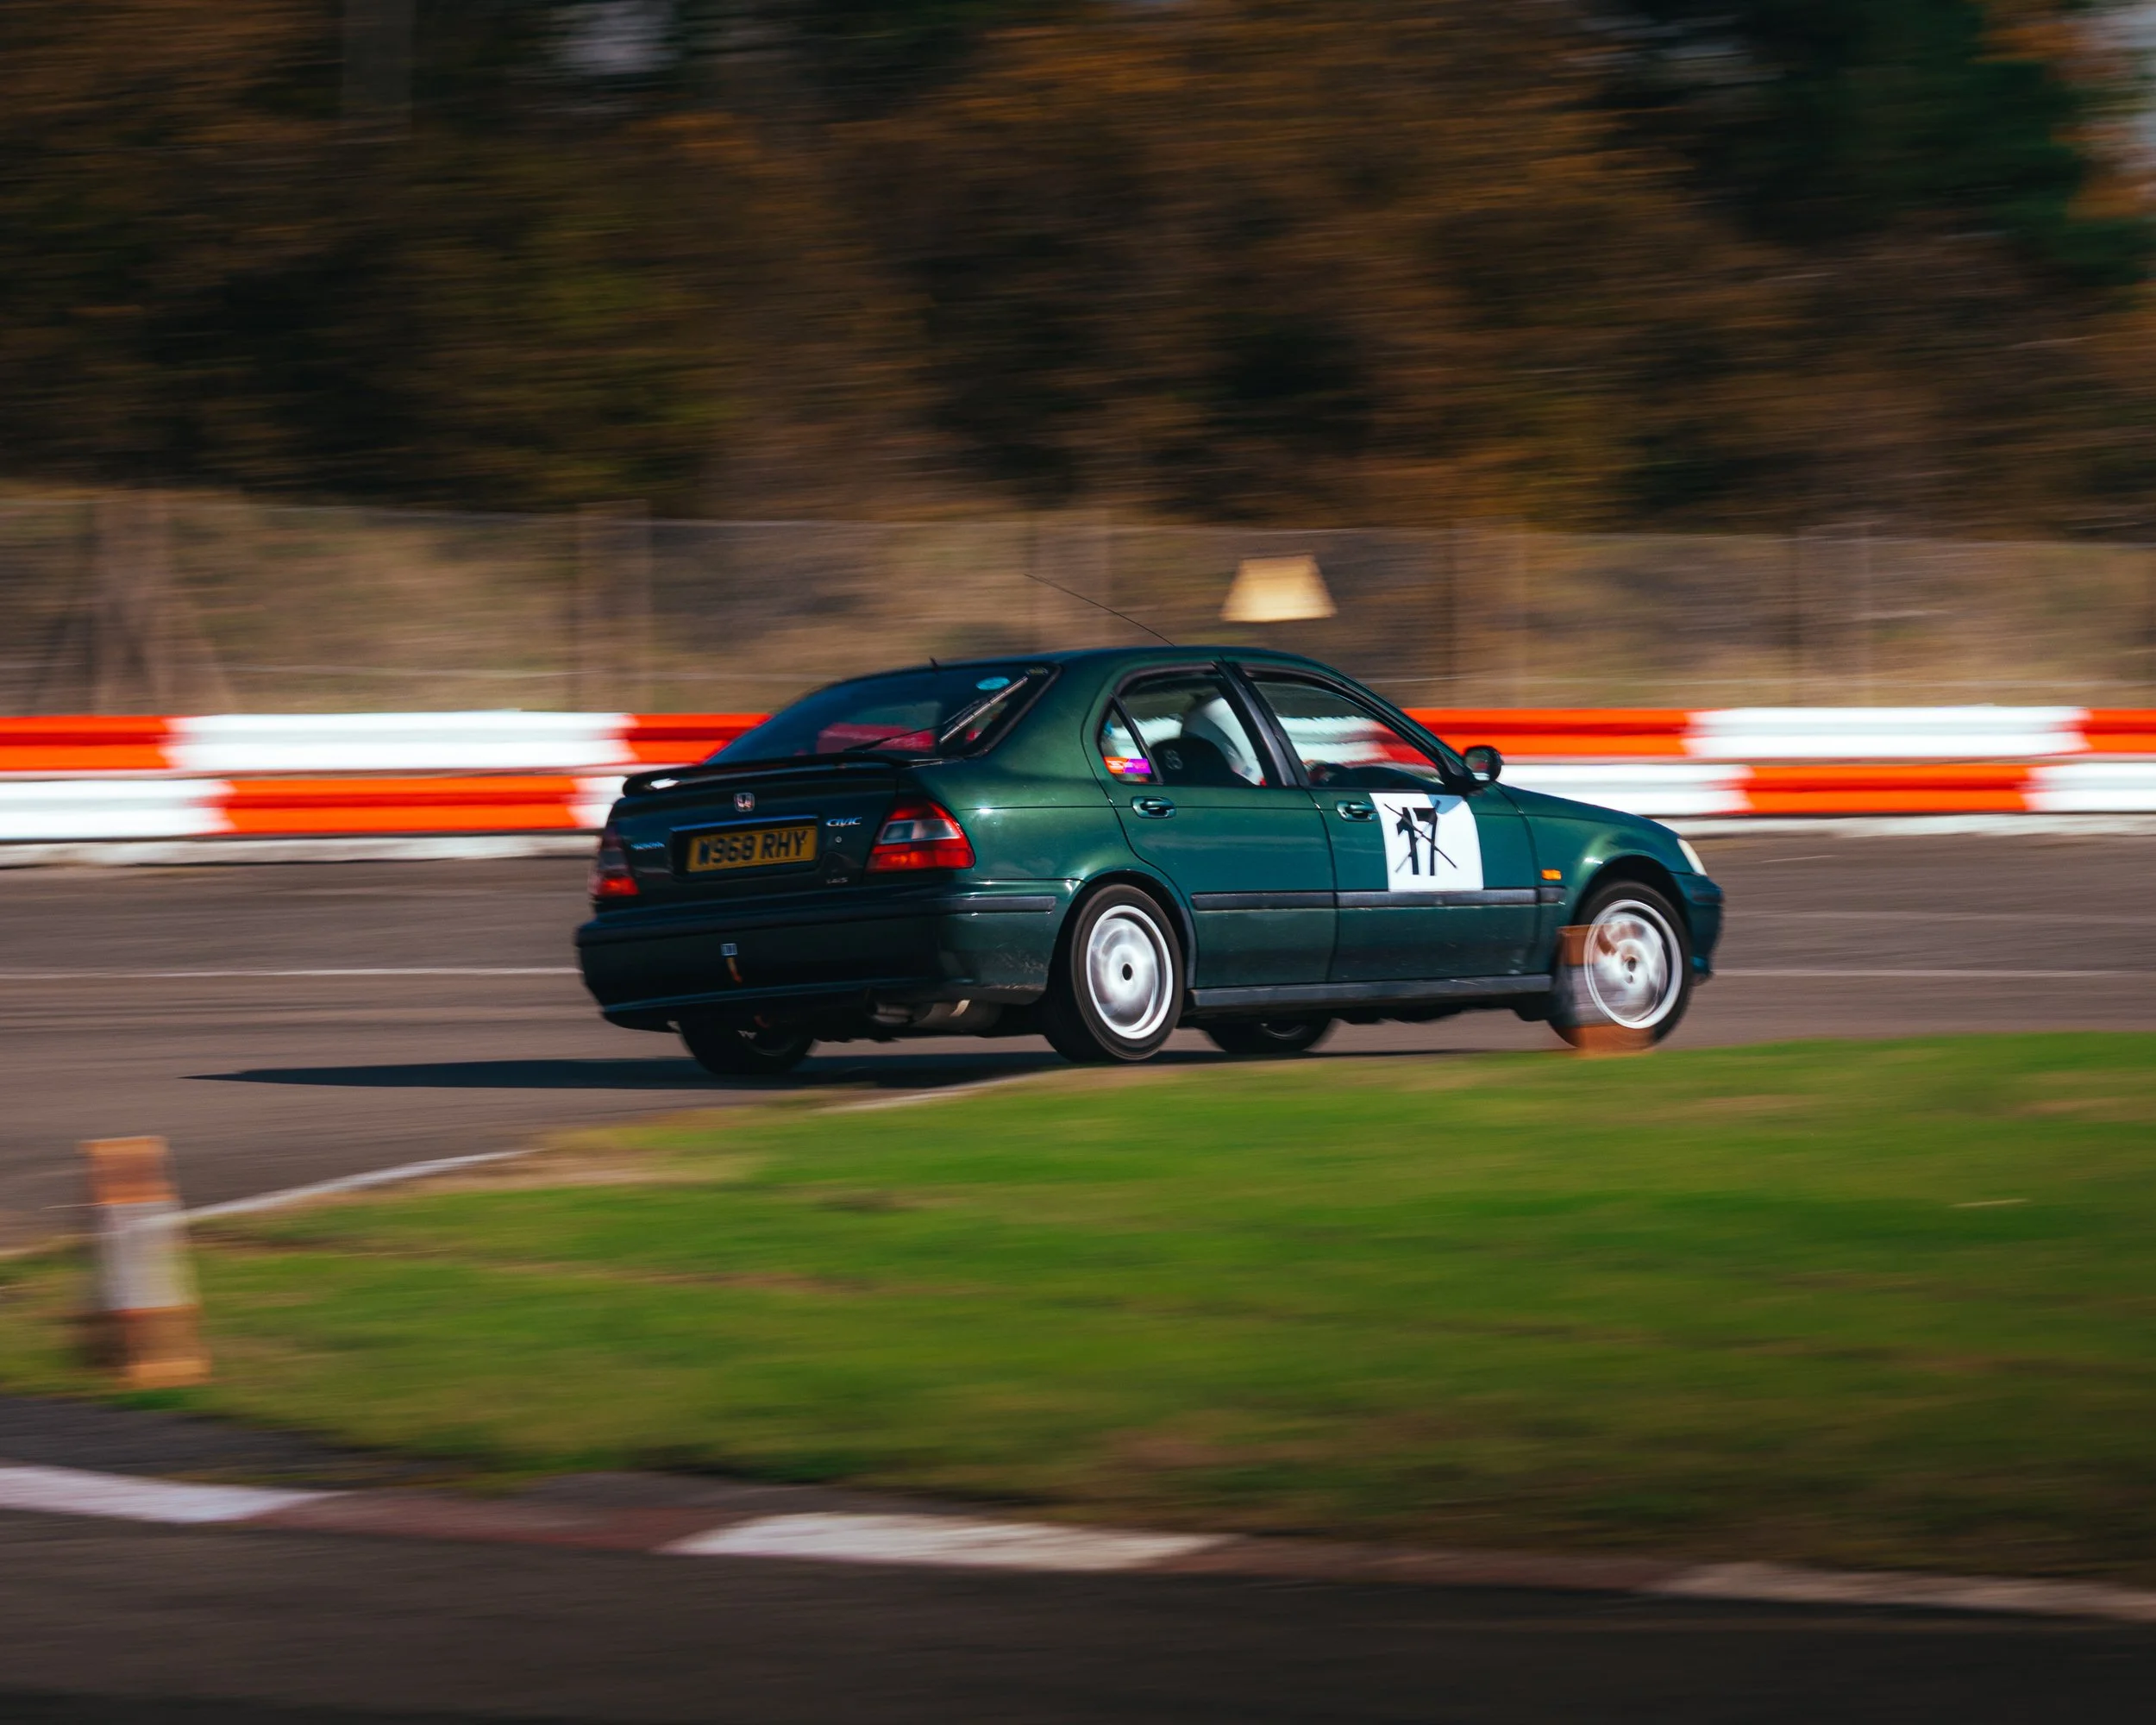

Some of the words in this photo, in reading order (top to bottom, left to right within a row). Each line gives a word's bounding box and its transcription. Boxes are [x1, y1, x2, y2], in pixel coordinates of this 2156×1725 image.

[825, 816, 862, 827] CIVIC
[760, 830, 808, 860] RHY
[1396, 806, 1438, 876] 17
